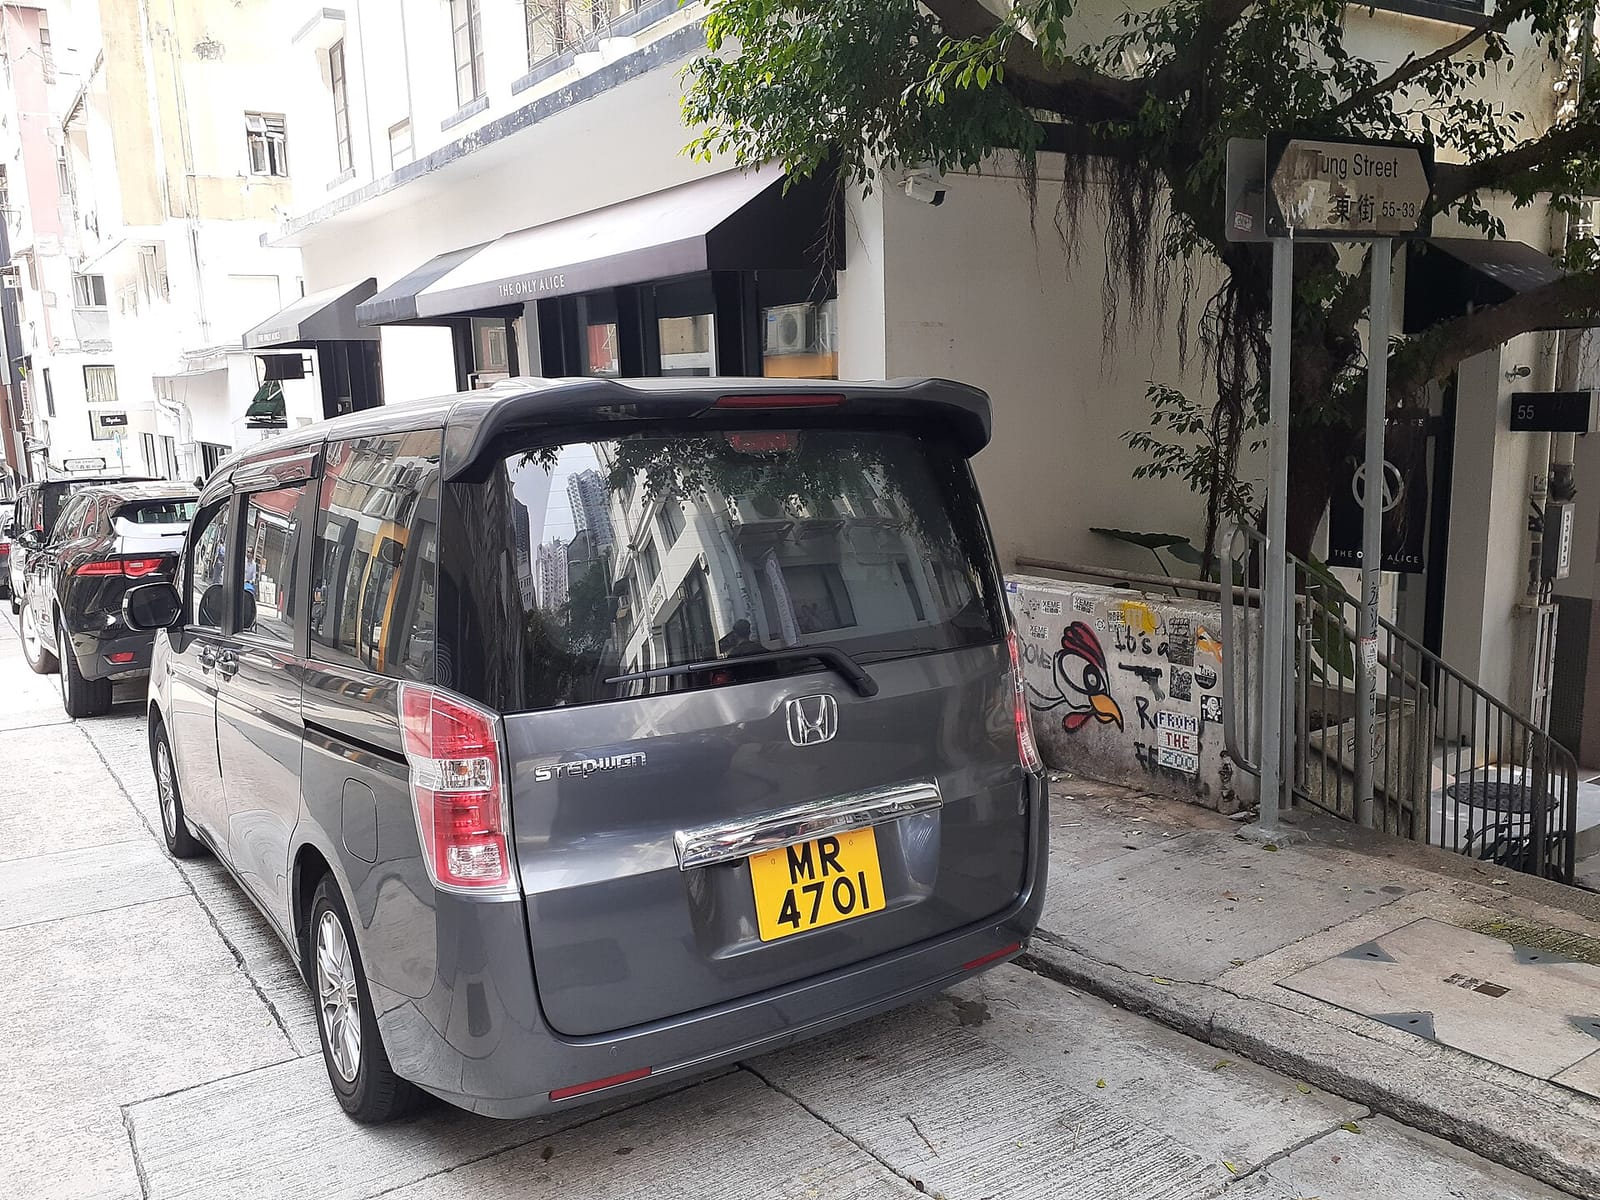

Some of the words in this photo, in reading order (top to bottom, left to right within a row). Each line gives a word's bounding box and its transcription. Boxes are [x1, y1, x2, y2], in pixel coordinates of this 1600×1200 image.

[1314, 151, 1347, 178] ung
[1353, 153, 1398, 178] Street
[1382, 200, 1415, 217] 55-33
[498, 283, 513, 297] THE
[515, 279, 537, 295] ONLY
[539, 274, 565, 291] ALICE
[1517, 404, 1535, 420] 55
[1334, 549, 1352, 558] THE
[1387, 553, 1420, 565] ALICE
[1159, 712, 1196, 732] FROM
[1165, 732, 1190, 750] THE
[1162, 750, 1195, 770] ZOO
[786, 836, 845, 885] MR
[777, 871, 870, 929] 4701
